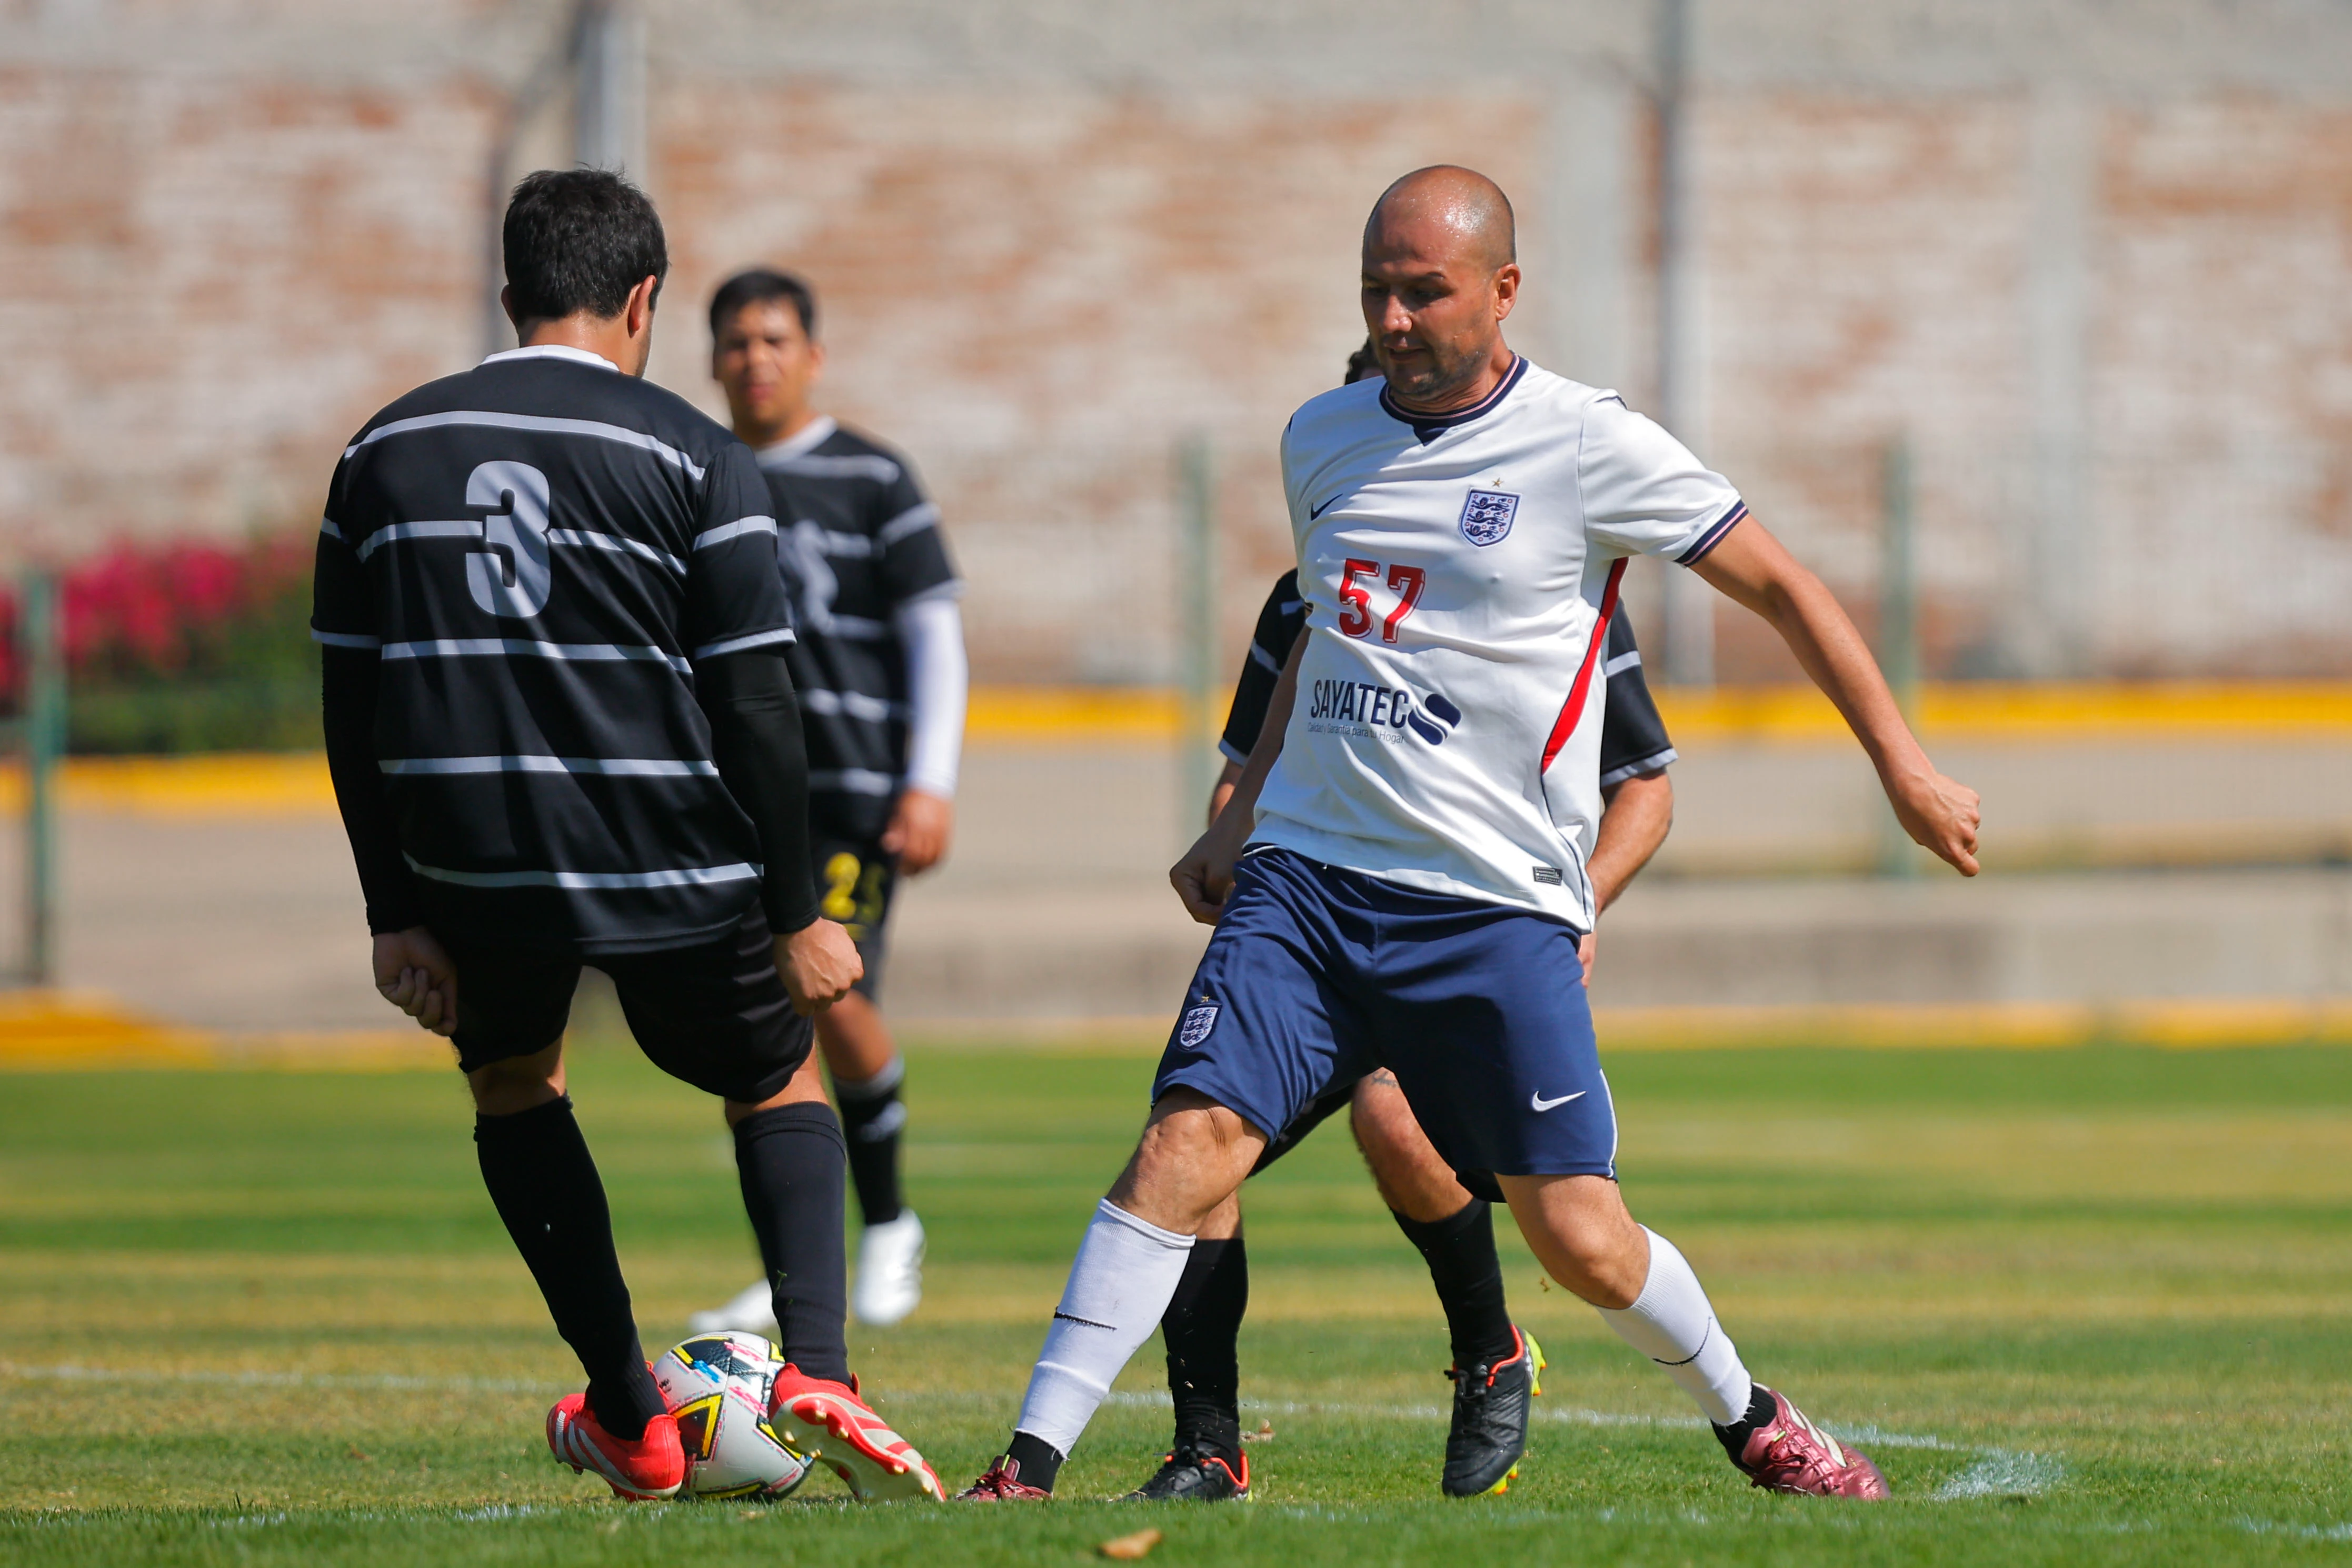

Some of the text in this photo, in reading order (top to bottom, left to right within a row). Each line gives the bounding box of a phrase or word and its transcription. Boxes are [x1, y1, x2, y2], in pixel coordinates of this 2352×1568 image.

[466, 460, 551, 618] 3
[1339, 558, 1426, 643] 57
[1311, 679, 1410, 728] SAYATEC
[1352, 727, 1369, 736] para
[1379, 730, 1404, 744] Hogar
